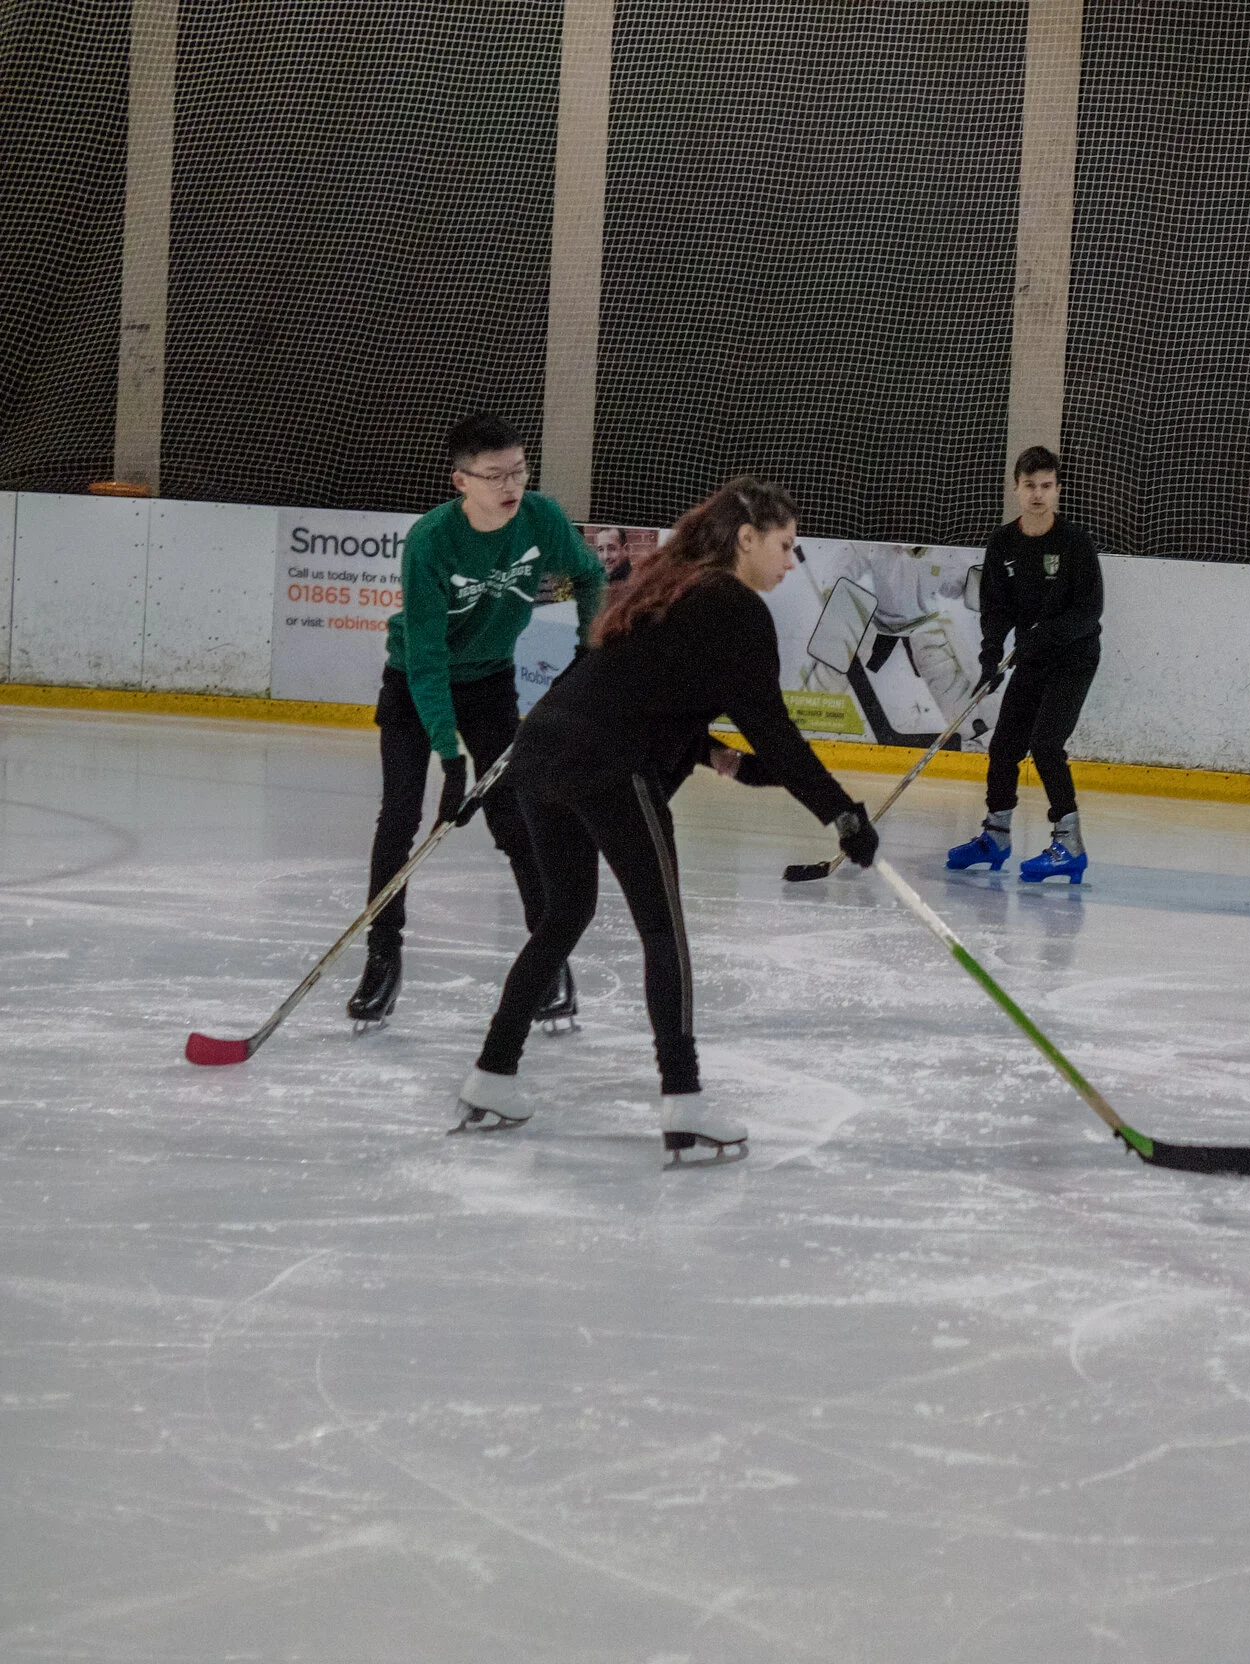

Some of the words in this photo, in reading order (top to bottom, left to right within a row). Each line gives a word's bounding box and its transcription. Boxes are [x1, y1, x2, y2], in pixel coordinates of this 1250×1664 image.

[291, 527, 406, 559] Smooth
[288, 567, 309, 579] Call
[312, 570, 325, 580] us
[328, 570, 359, 584] today
[361, 571, 378, 583] for
[288, 584, 351, 605] 01865
[358, 587, 404, 608] 5105
[285, 617, 298, 626] or
[300, 616, 325, 628] visit:
[328, 616, 389, 632] robinso
